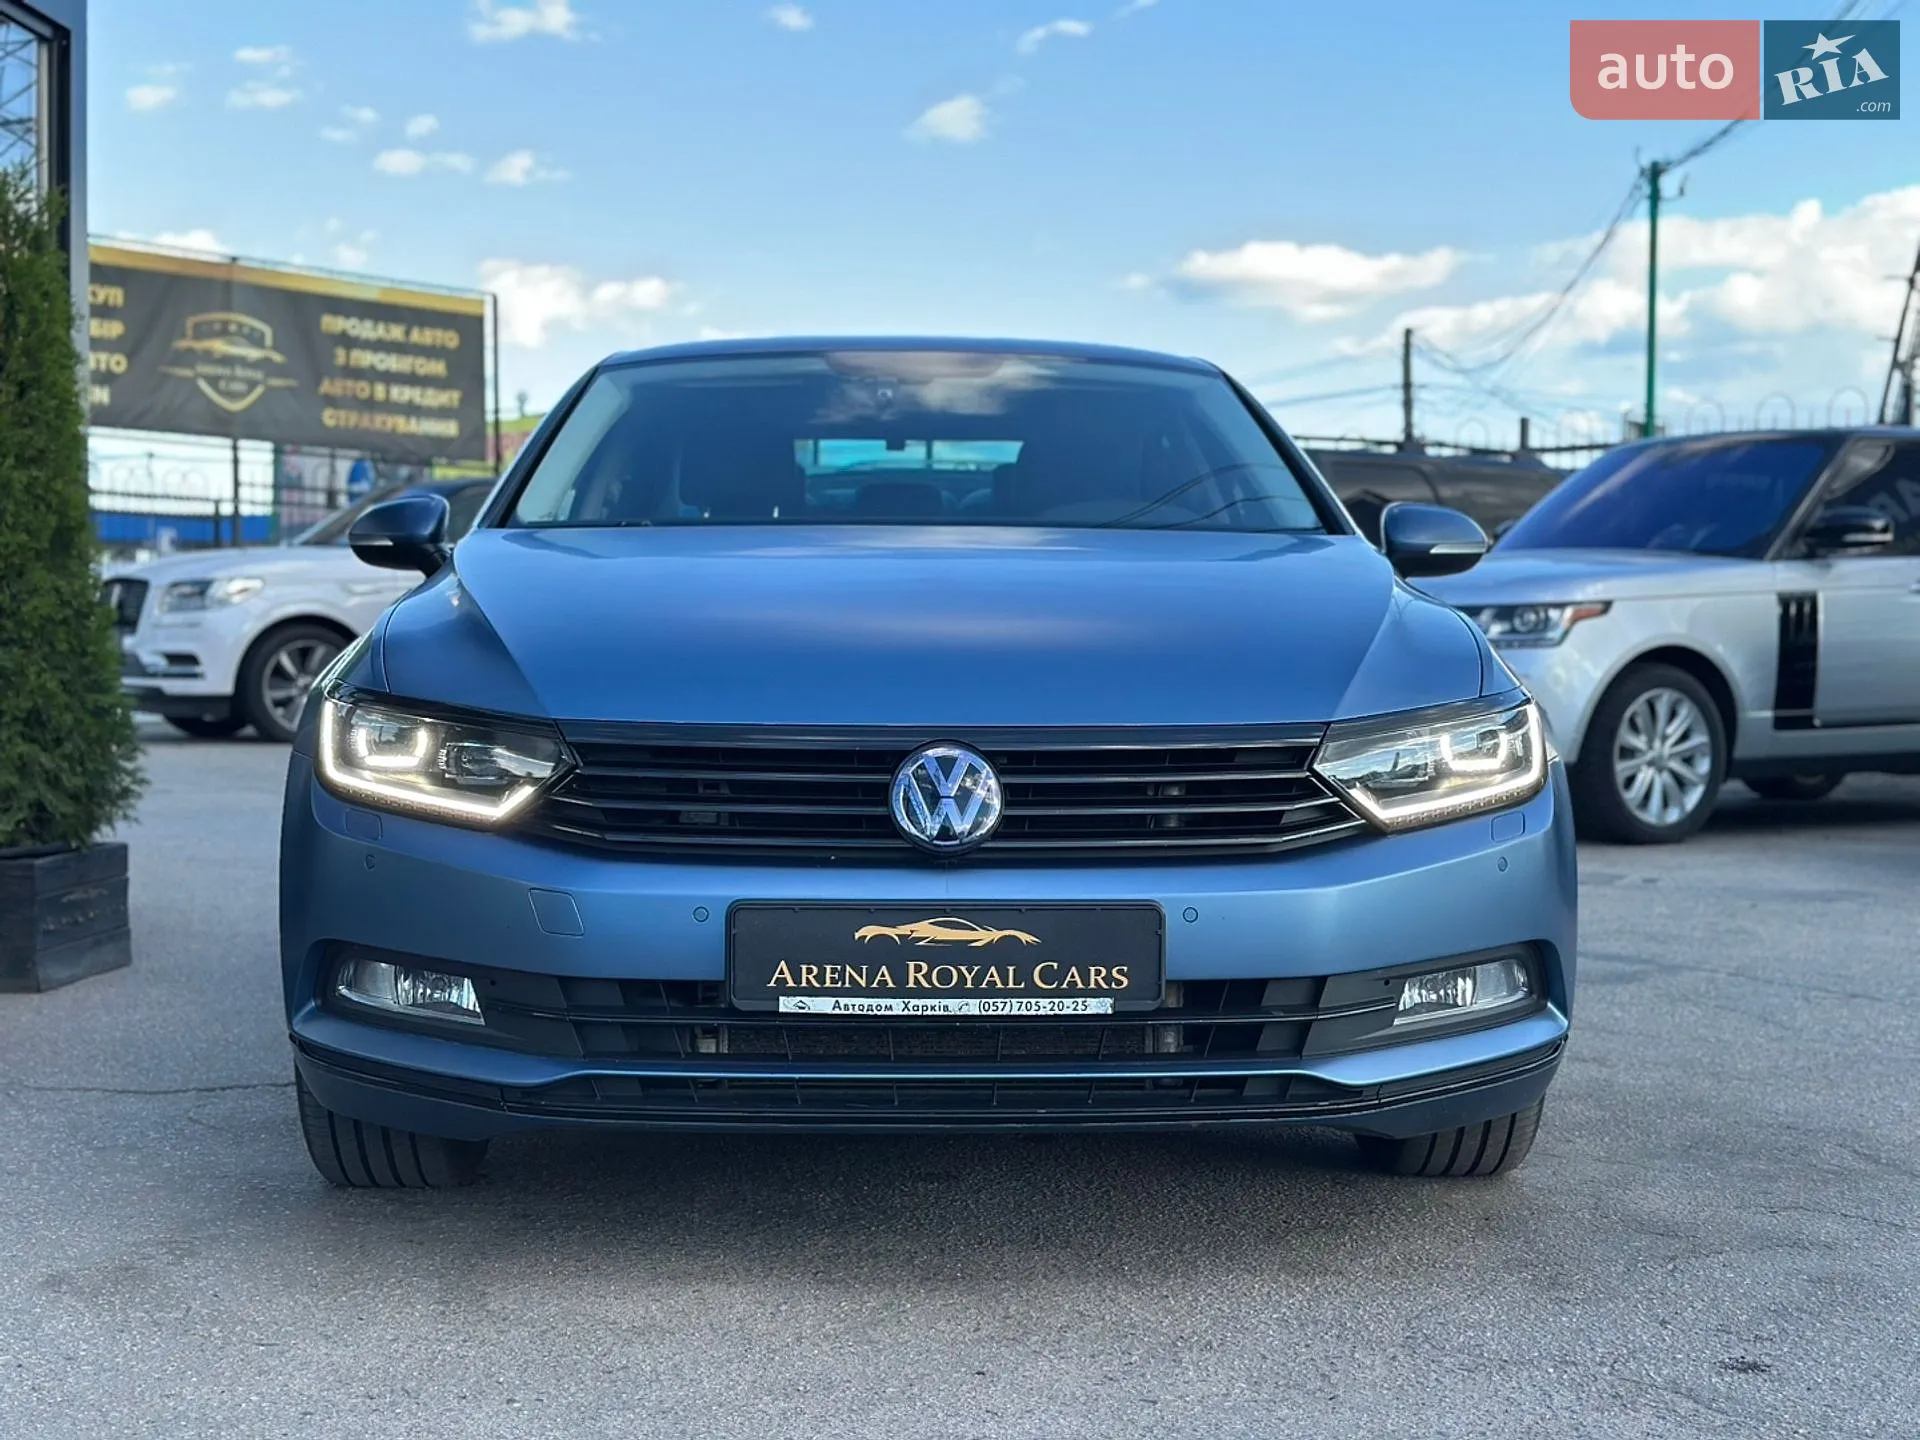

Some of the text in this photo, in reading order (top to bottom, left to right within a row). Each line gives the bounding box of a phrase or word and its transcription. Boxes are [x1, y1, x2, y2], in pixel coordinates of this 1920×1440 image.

[408, 326, 460, 349] АВТО
[319, 376, 372, 400] АВТО
[389, 382, 462, 409] КРЕДИТ
[767, 960, 1129, 990] ARENA ROYAL CARS
[832, 1000, 894, 1013] Автодом
